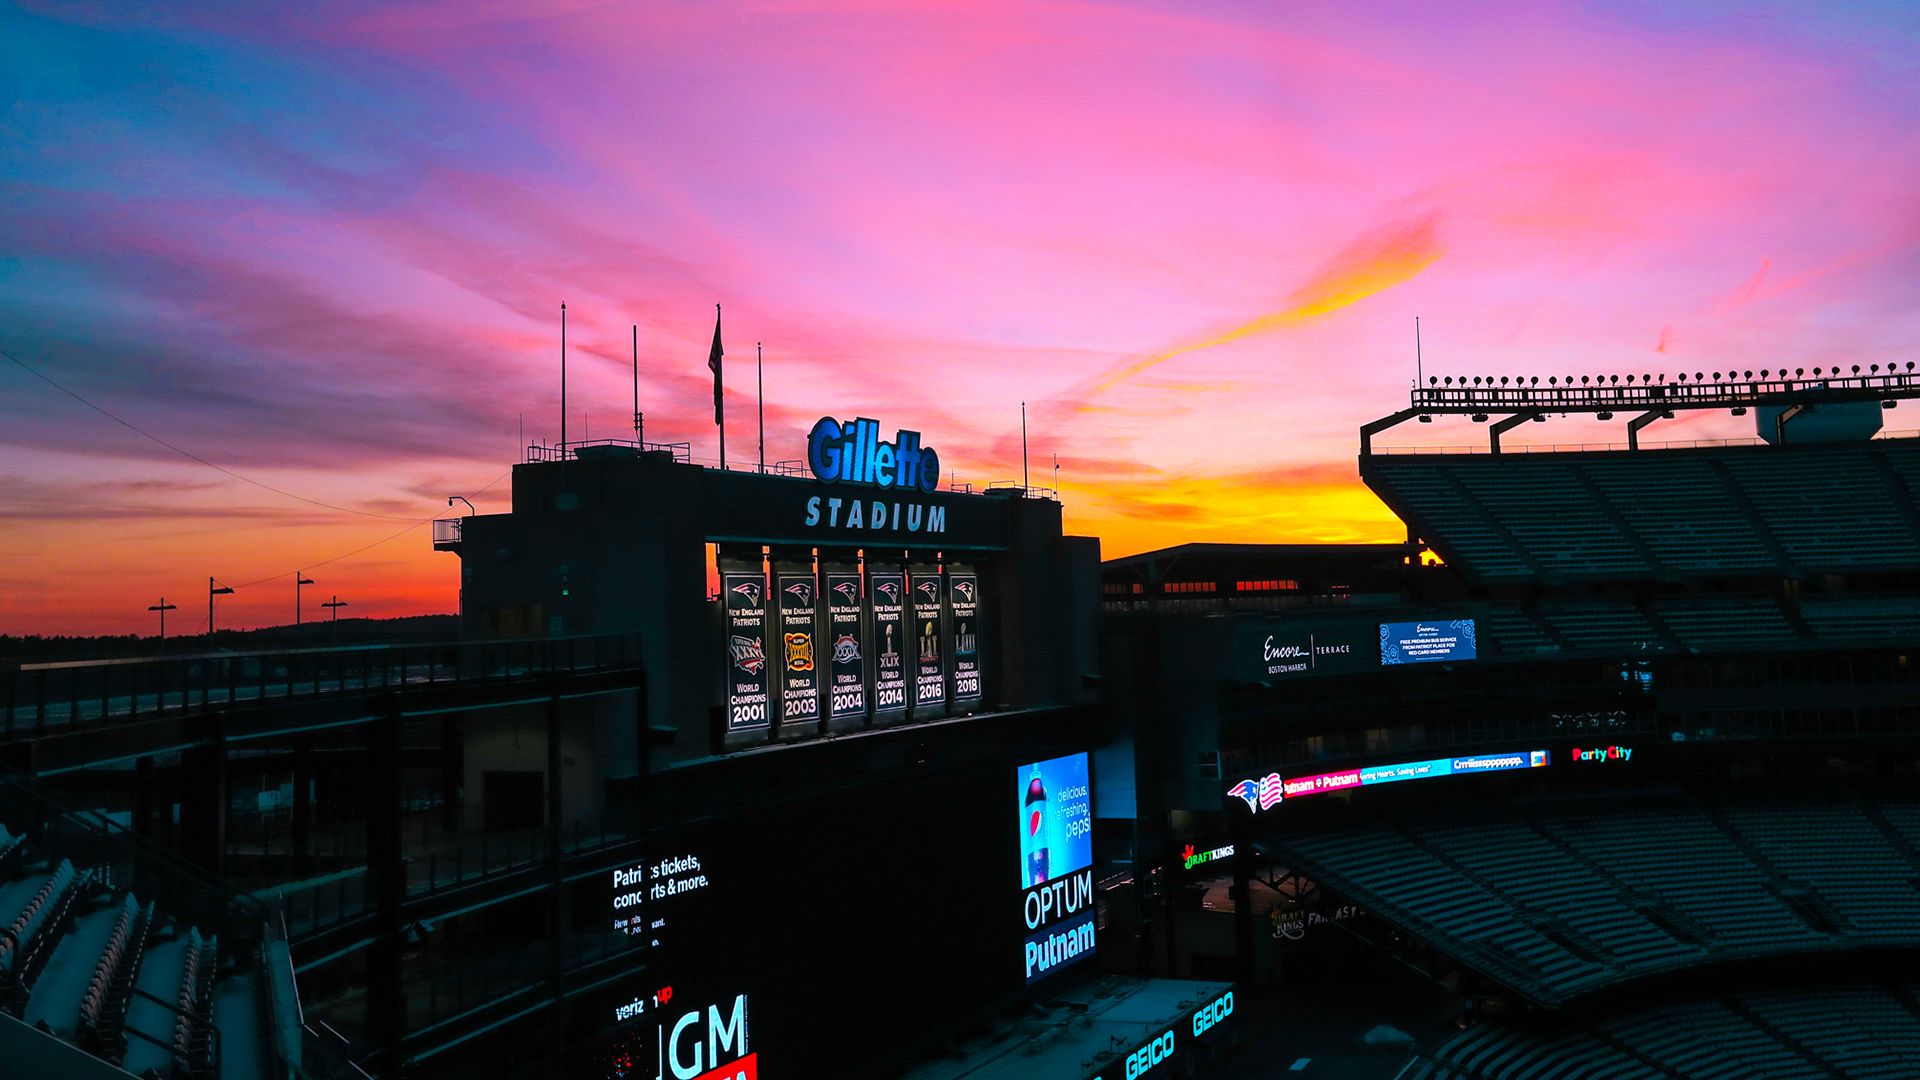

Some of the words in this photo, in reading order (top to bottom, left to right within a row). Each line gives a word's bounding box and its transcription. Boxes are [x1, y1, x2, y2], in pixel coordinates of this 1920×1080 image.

[810, 417, 939, 491] Gillette
[805, 496, 945, 533] STADIUM
[733, 618, 760, 626] PATRIOTS
[786, 616, 811, 625] PATRIOTS
[834, 614, 857, 622] PATRIOTS
[878, 613, 899, 621] PATRIOTS
[1264, 635, 1310, 662] Encore
[1316, 645, 1350, 655] TERRACE
[880, 656, 900, 668] XLIX
[1268, 665, 1288, 674] BOSTON
[1288, 663, 1307, 672] HARBOR
[837, 674, 856, 684] WORLD
[881, 670, 899, 679] WORLD
[736, 684, 760, 693] WORLD
[789, 679, 810, 688] WORLD
[833, 684, 862, 694] CHAMPIONS
[957, 679, 978, 693] 2018
[730, 694, 766, 704] CHAMPIONS
[784, 688, 816, 699] CHAMPIONS
[880, 689, 903, 706] 2014
[919, 684, 942, 699] 2016
[785, 698, 816, 716] 2003
[834, 693, 862, 710] 2004
[733, 704, 765, 722] 2001
[1323, 774, 1358, 788] Putnam
[1058, 785, 1087, 802] delicious.
[1066, 813, 1091, 842] pepsi
[1184, 845, 1235, 870] DRAFTKINGS
[661, 855, 701, 876] tickets,
[613, 883, 666, 909] concrts
[667, 878, 676, 896] &
[677, 875, 709, 894] more.
[1025, 870, 1092, 930] OPTUM
[1026, 921, 1095, 978] Putnam
[1193, 991, 1234, 1037] GEICO
[1125, 1030, 1175, 1080] GEICO
